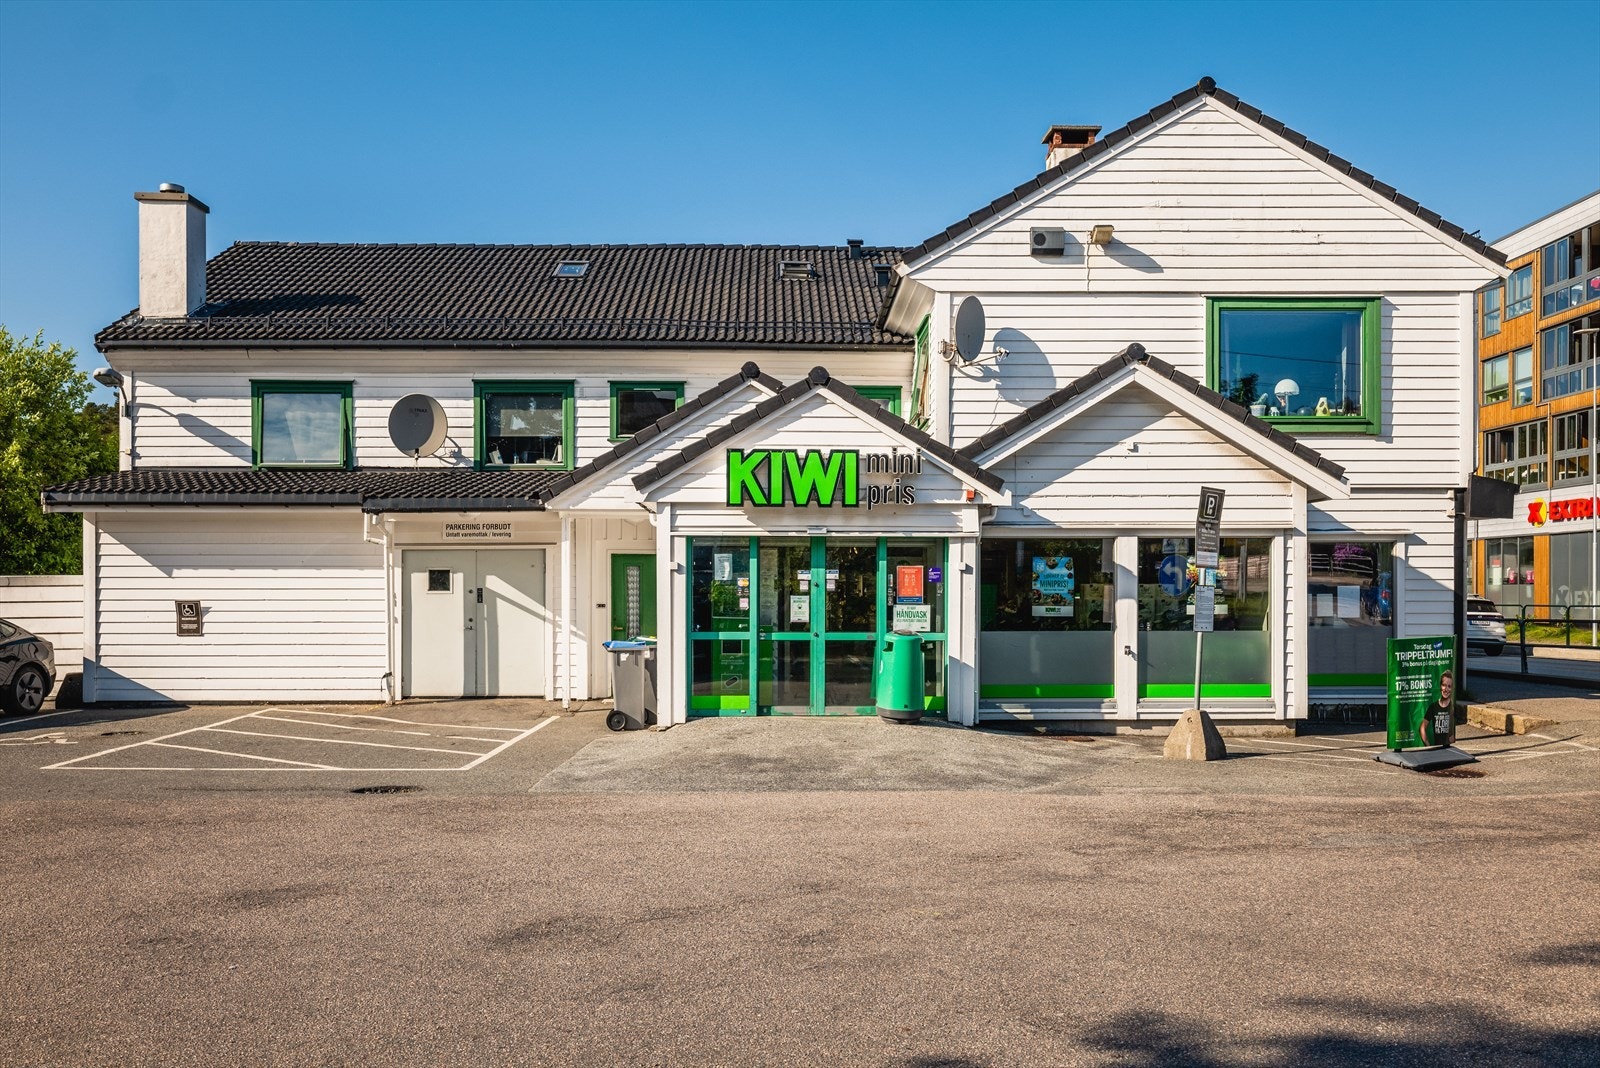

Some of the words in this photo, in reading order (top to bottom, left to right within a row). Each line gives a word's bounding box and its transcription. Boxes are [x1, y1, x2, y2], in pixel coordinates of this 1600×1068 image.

[866, 447, 922, 474] mini
[726, 448, 859, 507] KIWI
[866, 478, 916, 511] pris
[445, 523, 481, 531] PARKERING
[482, 523, 512, 531] FORBUDT
[896, 609, 928, 619] HÅNDVASK
[1395, 649, 1453, 661] TRIPPELTRUMF!
[1395, 681, 1409, 691] 17%
[1410, 679, 1433, 690] BONUS
